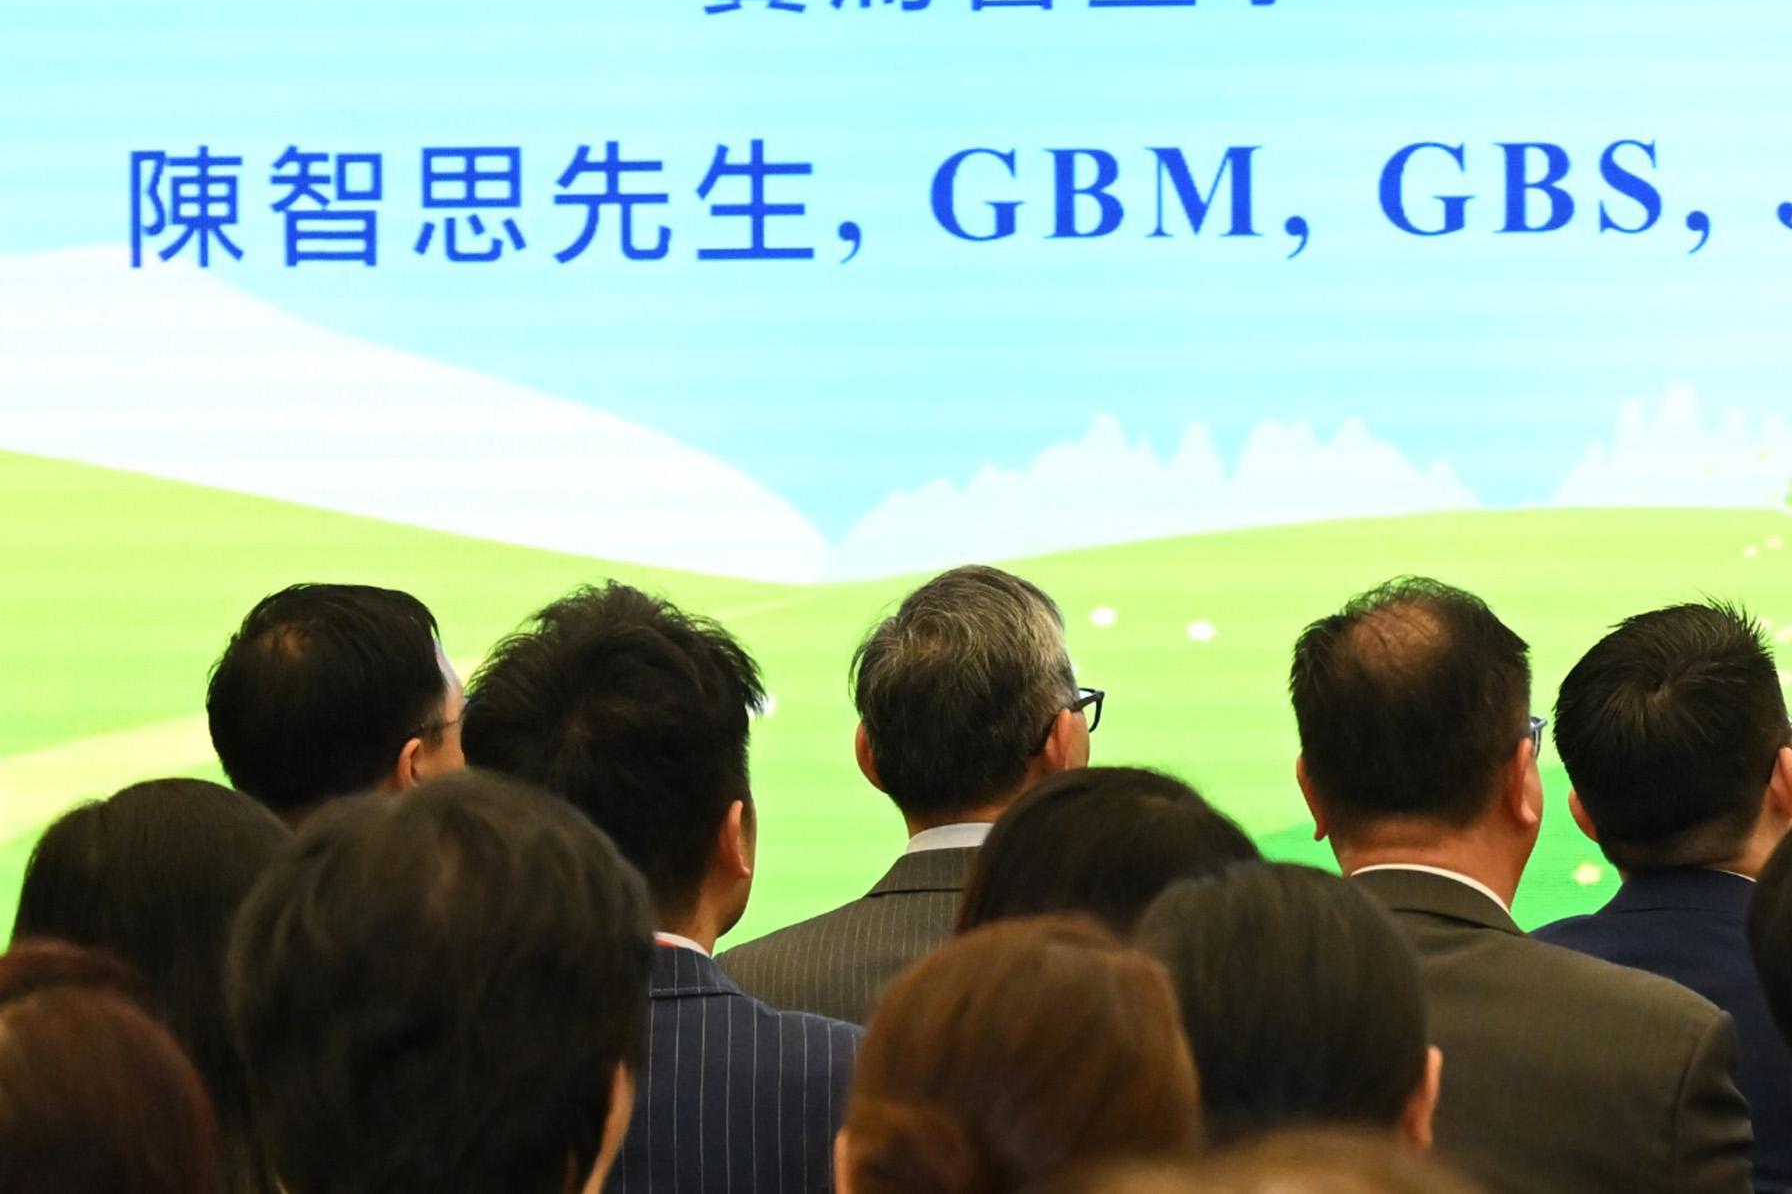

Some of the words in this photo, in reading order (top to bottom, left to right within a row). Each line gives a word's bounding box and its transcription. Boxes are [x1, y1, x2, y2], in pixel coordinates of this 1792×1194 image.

[129, 137, 863, 264] 陳智思先生,
[929, 144, 1311, 260] GBM,
[1377, 138, 1712, 255] GBS,
